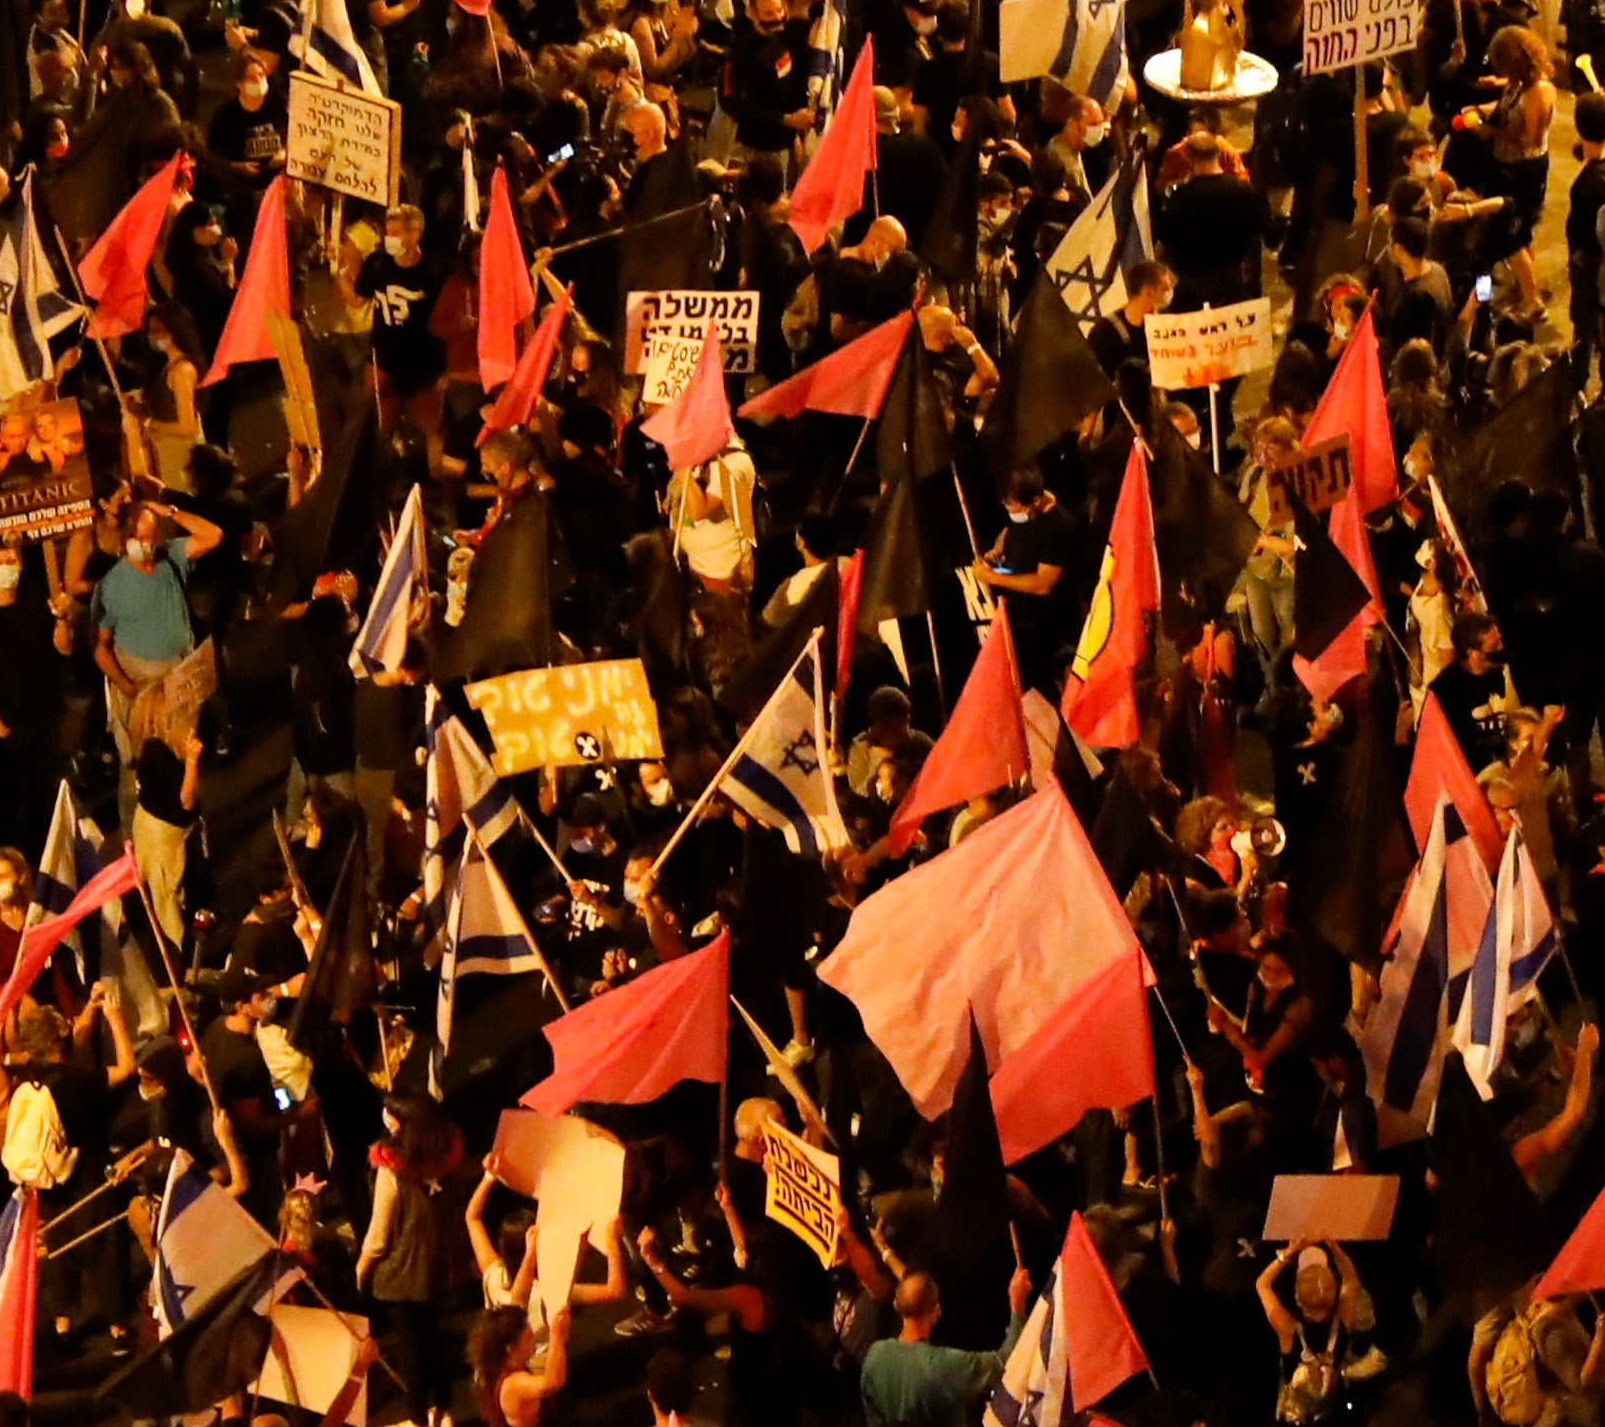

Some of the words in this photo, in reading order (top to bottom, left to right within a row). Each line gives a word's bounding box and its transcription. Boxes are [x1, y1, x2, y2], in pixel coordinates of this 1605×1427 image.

[1365, 14, 1414, 56] בפני
[643, 296, 754, 321] ממשלה
[767, 1135, 831, 1200] נכשלת
